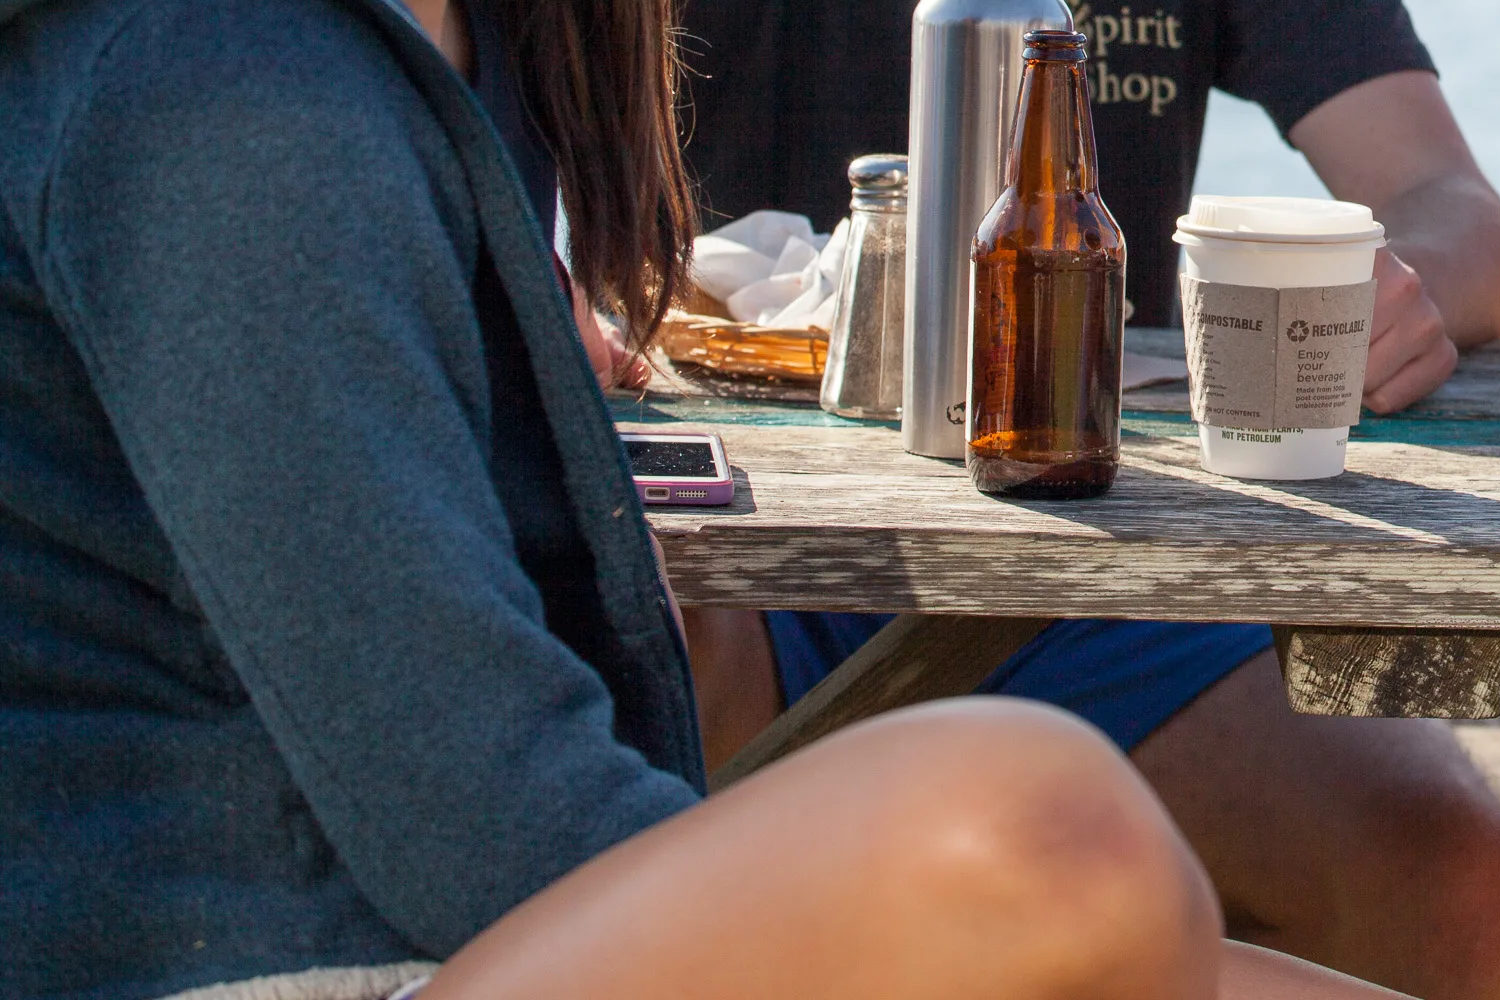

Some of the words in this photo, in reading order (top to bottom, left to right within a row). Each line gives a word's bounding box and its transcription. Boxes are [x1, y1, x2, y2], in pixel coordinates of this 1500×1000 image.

[1085, 60, 1177, 117] hop
[1312, 319, 1365, 337] RECYCLABLE
[1298, 349, 1330, 361] Enjoy
[1297, 362, 1324, 373] your
[1296, 371, 1346, 383] beverage!
[1295, 394, 1311, 402] post
[1295, 401, 1333, 409] unbleached
[1225, 409, 1261, 418] CONTENTS
[1221, 430, 1234, 440] NOT
[1236, 432, 1282, 443] PETROLEUM
